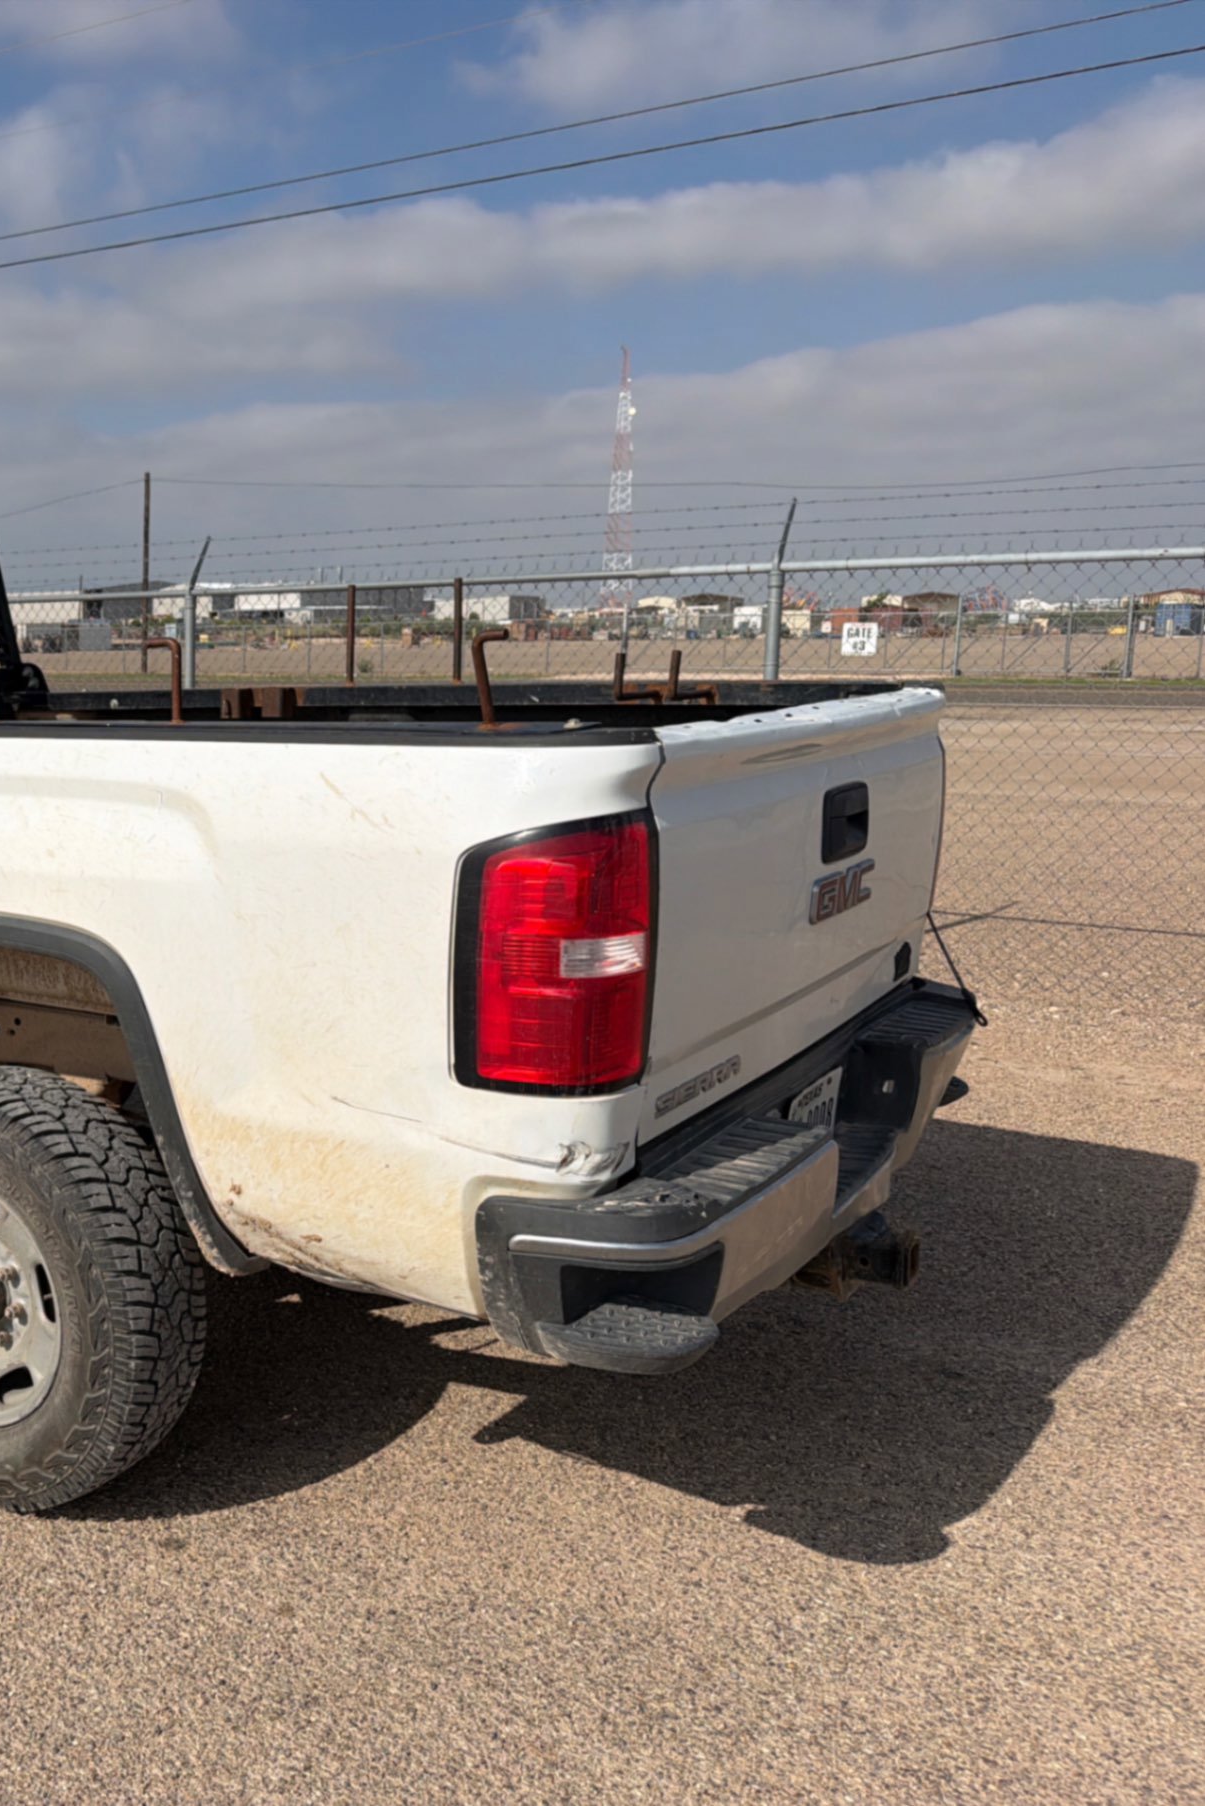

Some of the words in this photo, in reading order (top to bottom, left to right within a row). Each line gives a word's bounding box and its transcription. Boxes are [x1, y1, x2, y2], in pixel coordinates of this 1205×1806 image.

[847, 627, 873, 639] GATE
[809, 858, 875, 926] GMC
[655, 1054, 741, 1119] SIERRA
[797, 1082, 823, 1108] TEXAS
